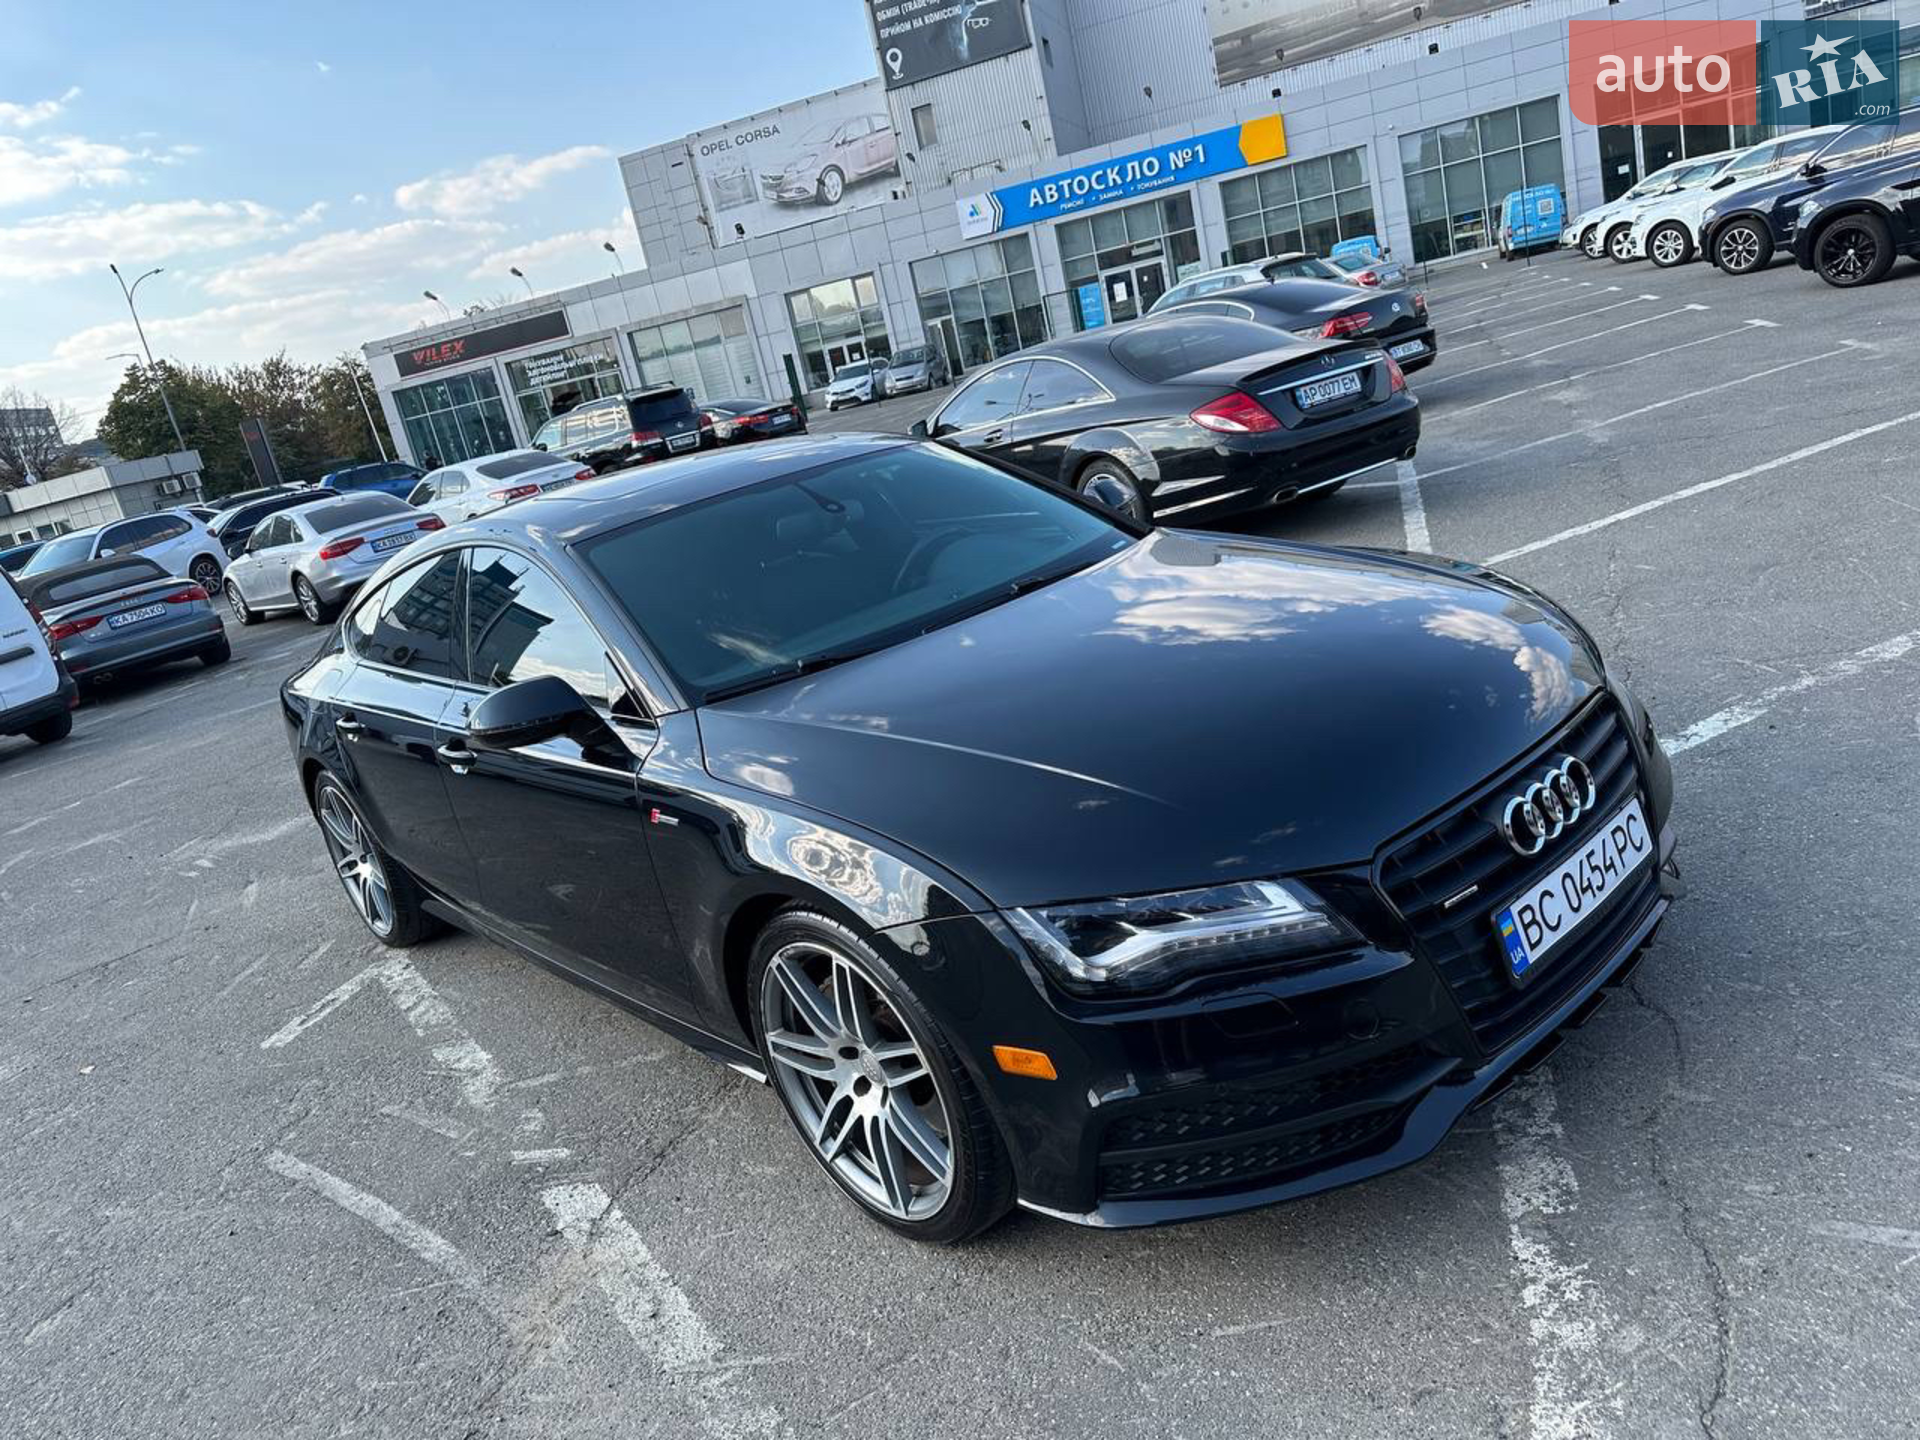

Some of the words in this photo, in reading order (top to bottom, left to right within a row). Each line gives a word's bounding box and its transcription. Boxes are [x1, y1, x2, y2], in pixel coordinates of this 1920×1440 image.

[913, 18, 924, 28] НА
[701, 141, 731, 156] OPEL
[735, 125, 780, 146] CORSA
[1029, 156, 1159, 208] АВТОСКЛО
[1168, 144, 1206, 170] №1
[413, 340, 466, 364] VILEX
[1517, 890, 1561, 952] BC
[1561, 838, 1618, 914] 0454
[1610, 813, 1643, 869] PC
[1510, 947, 1525, 963] UA
